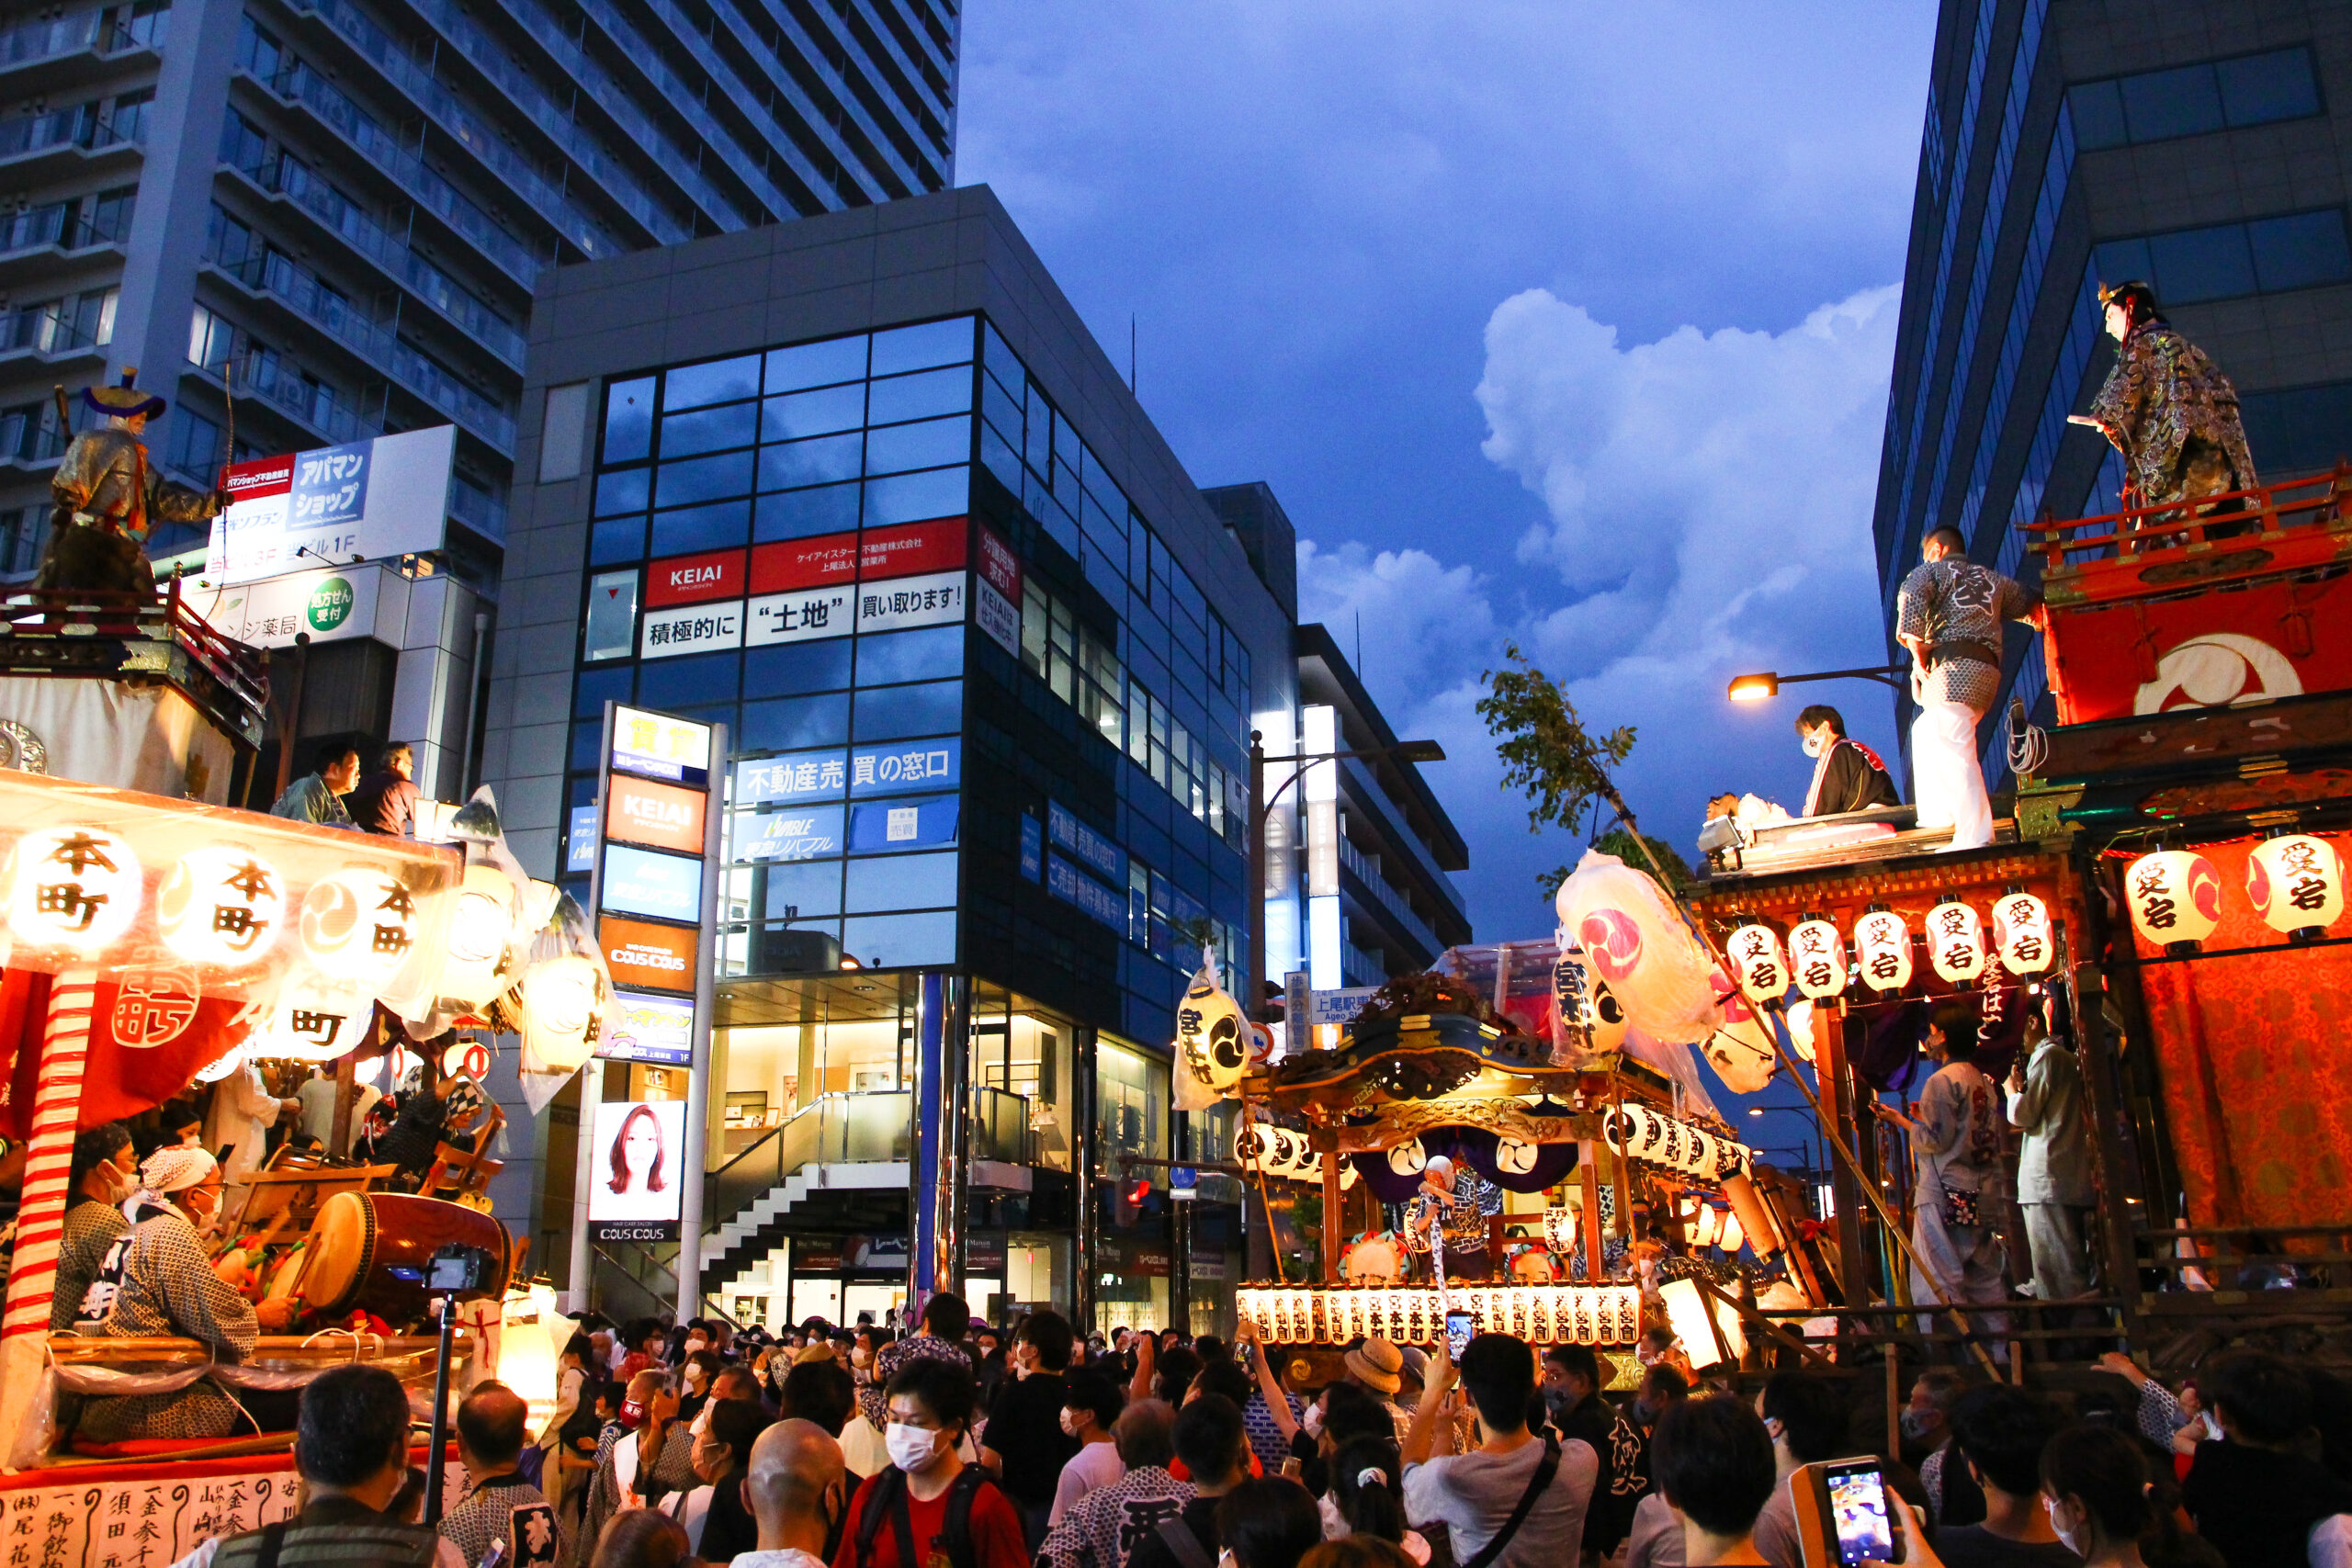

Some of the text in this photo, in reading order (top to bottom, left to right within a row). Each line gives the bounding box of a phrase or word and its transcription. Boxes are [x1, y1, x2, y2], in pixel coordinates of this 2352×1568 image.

[300, 454, 364, 487] アパマン
[296, 482, 359, 517] ショップ
[334, 535, 356, 553] 1F
[670, 564, 722, 587] KEIAI
[310, 589, 352, 609] 処方せん
[316, 605, 342, 623] 受付
[228, 615, 298, 640] ンジ薬局
[649, 615, 736, 647] 積極的に
[746, 750, 950, 797] 不動産売買の窓口
[623, 794, 692, 827] KEIAI
[741, 835, 834, 859] 東急リバブル
[36, 831, 120, 933] 本町
[2282, 840, 2328, 911] 愛宕
[212, 858, 278, 951] 本町
[2134, 862, 2177, 930] 愛宕
[371, 879, 415, 957] 本町
[2009, 898, 2042, 961] 愛宕
[1869, 918, 1899, 979] 愛宕
[1941, 908, 1974, 969] 愛宕
[610, 949, 685, 972] COUS COUS
[1744, 930, 1777, 989] 愛宕
[1799, 927, 1833, 987] 愛宕
[1316, 995, 1376, 1013] 上尾駅東
[1325, 1012, 1346, 1021] Ageo
[680, 1052, 690, 1063] 1F
[600, 1228, 664, 1240] COUS COUS
